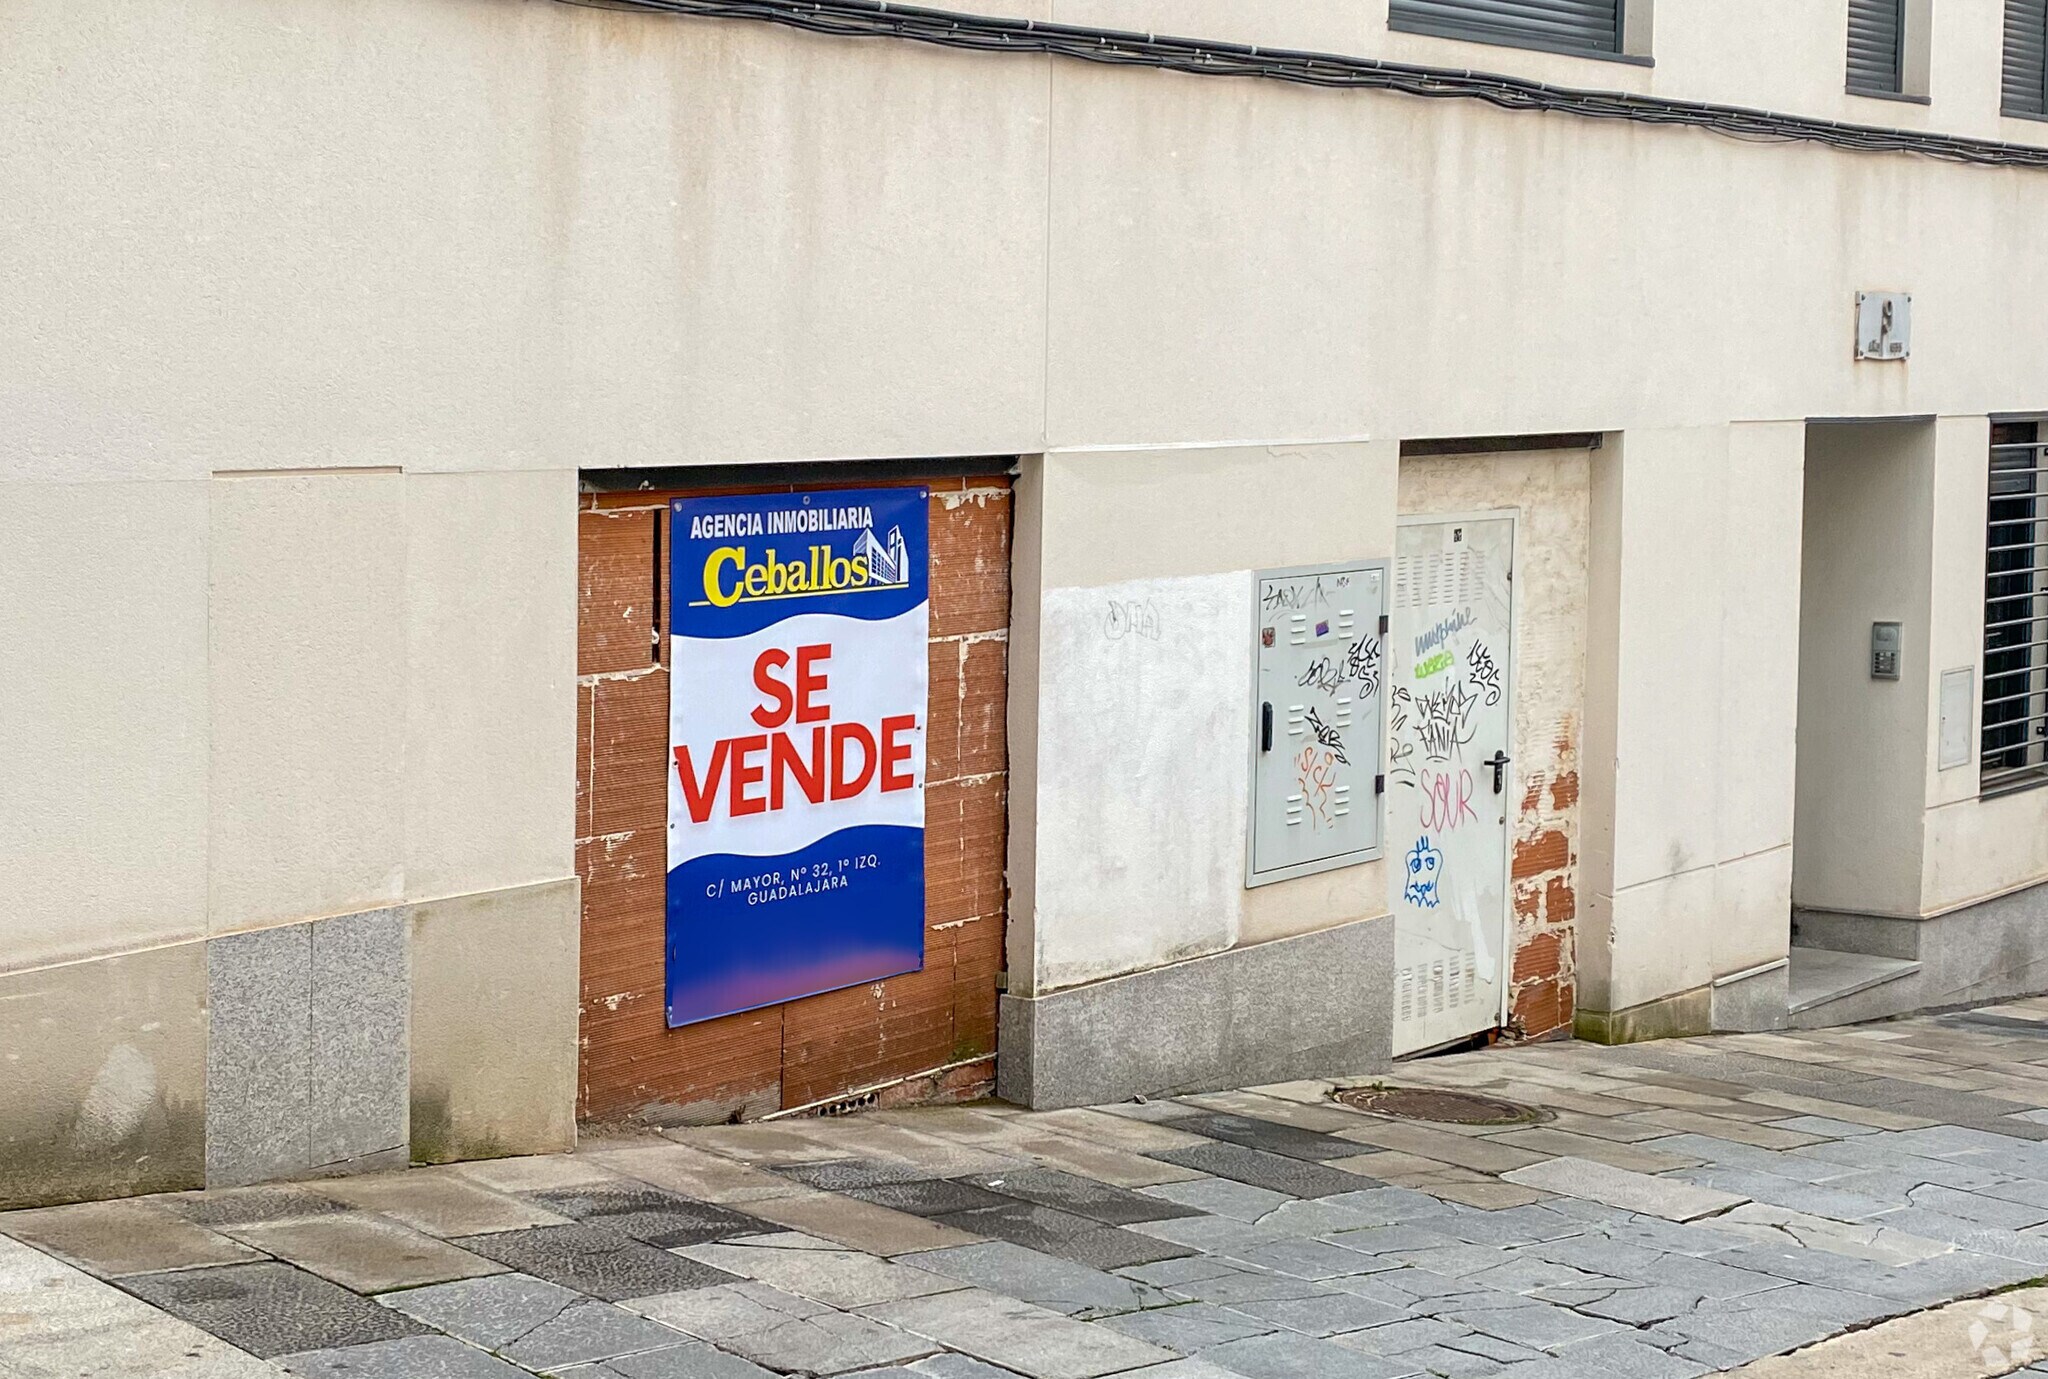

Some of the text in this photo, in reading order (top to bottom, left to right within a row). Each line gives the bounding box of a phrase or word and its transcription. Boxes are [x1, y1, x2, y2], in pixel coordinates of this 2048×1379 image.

[690, 507, 873, 539] AGENCIA INMOBILIARIA
[703, 545, 869, 607] Ceballos
[750, 643, 832, 729] SE
[673, 714, 916, 823] VENDE
[706, 879, 725, 898] C/
[731, 873, 785, 893] MAYOR,
[812, 863, 833, 878] 32,
[855, 854, 881, 870] IZQ.
[747, 875, 848, 905] GUADALAJARA
